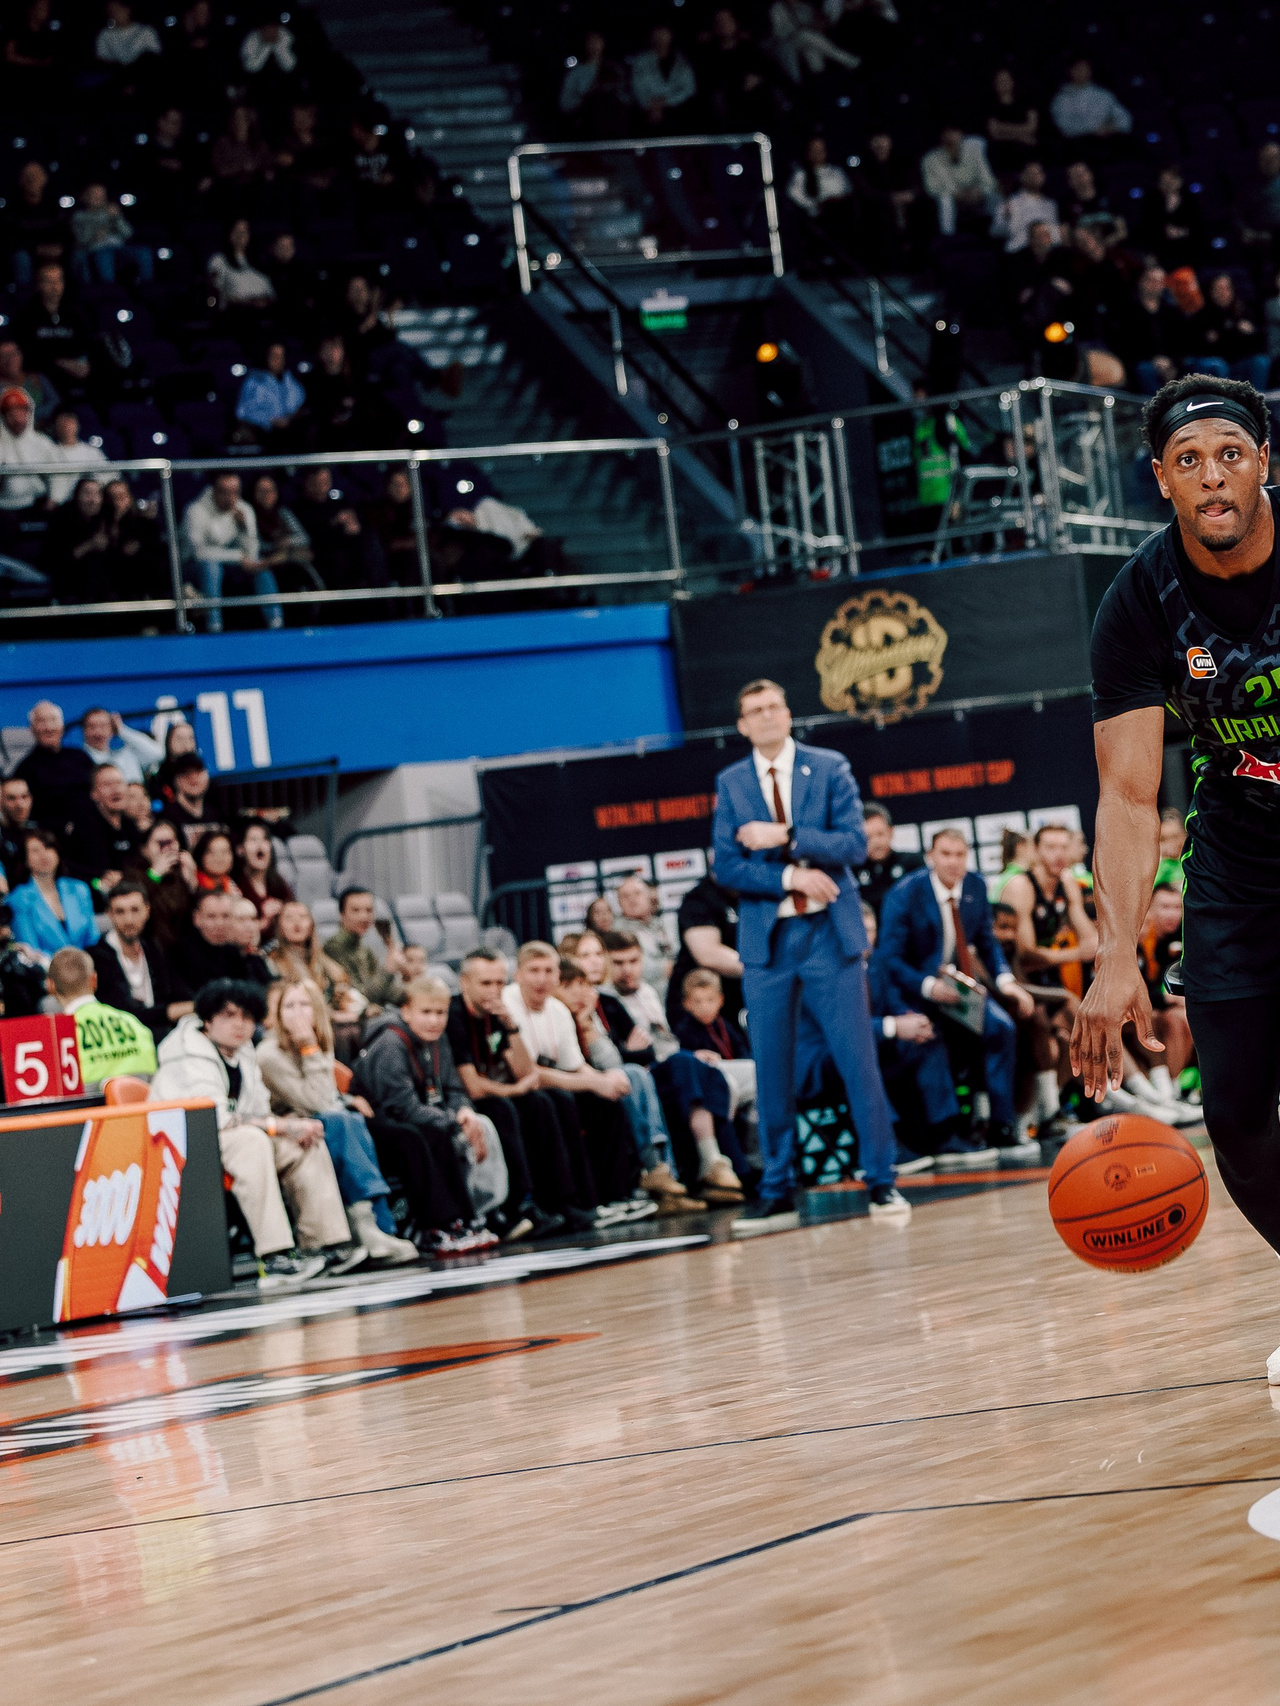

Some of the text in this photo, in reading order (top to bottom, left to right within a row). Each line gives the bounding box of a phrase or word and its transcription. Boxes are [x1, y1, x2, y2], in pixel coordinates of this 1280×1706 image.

[1195, 657, 1213, 668] WIN
[14, 1037, 79, 1096] 5 5
[1091, 1217, 1166, 1247] WINLINE
